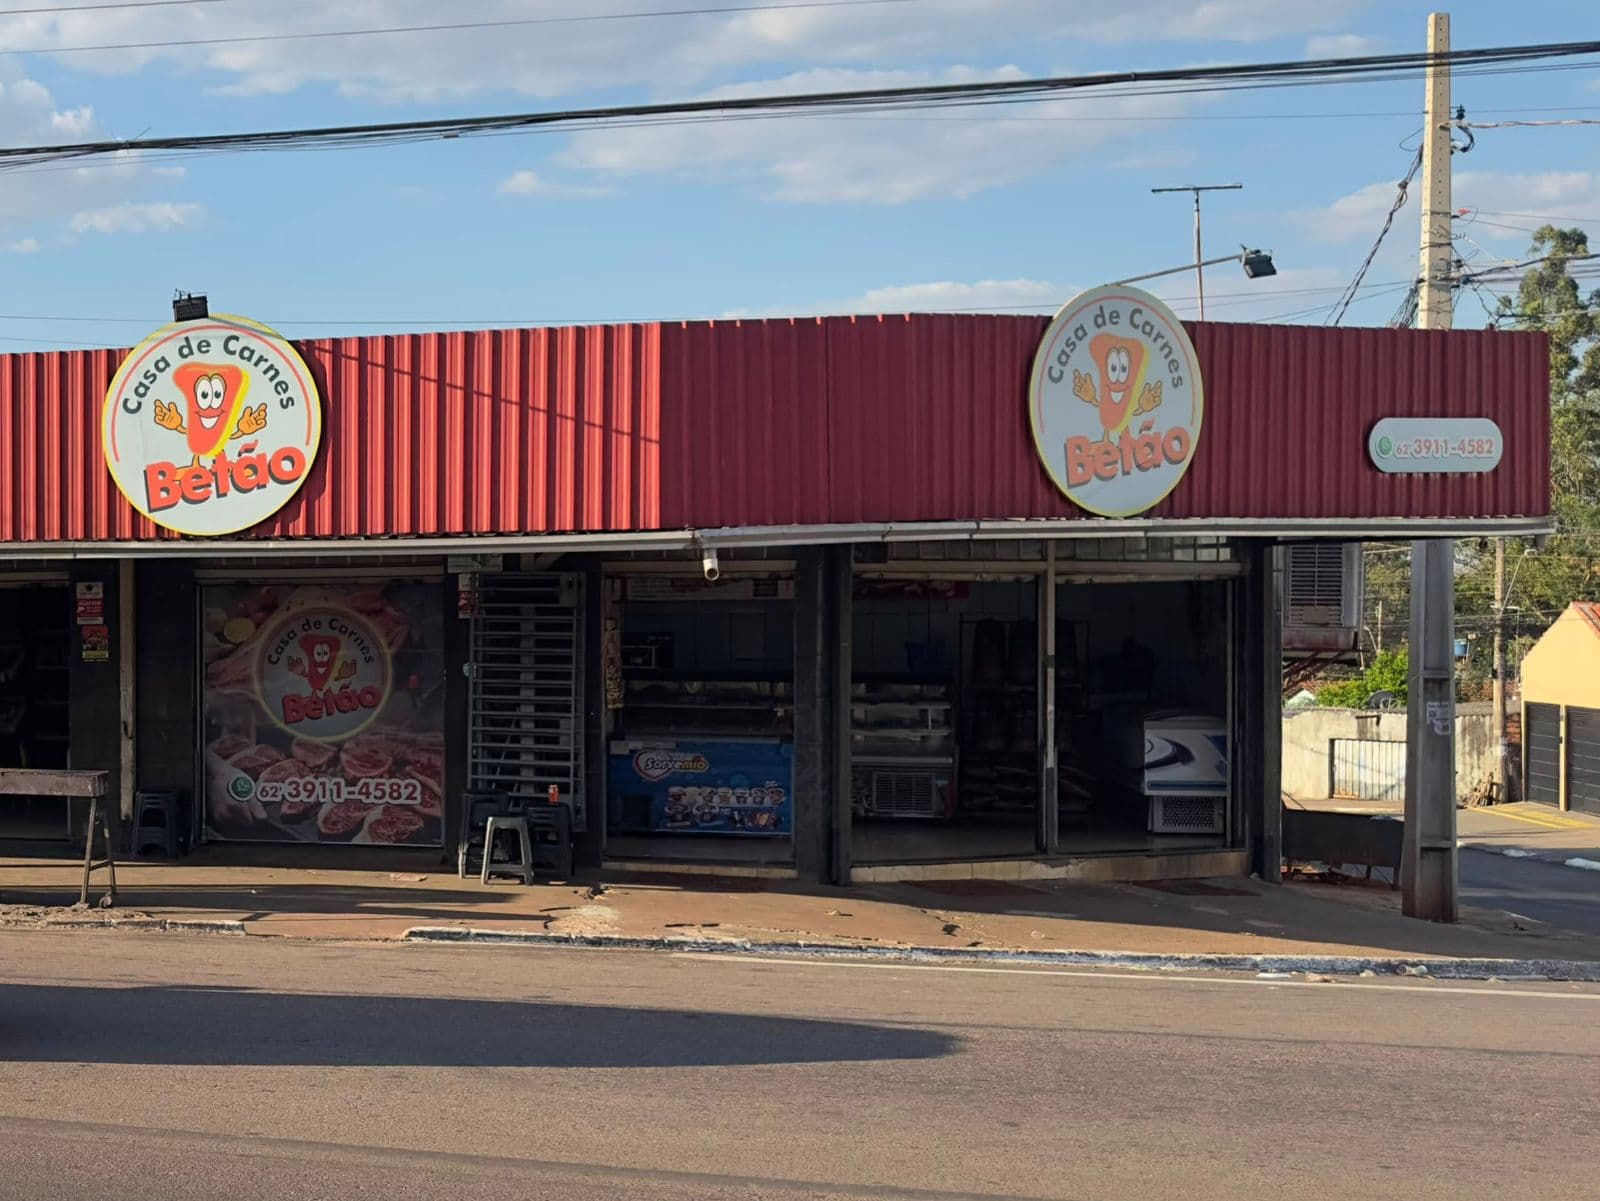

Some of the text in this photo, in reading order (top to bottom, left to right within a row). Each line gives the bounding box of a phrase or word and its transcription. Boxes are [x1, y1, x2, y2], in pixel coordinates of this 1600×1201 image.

[122, 335, 295, 415] Casa de Carnes
[1048, 305, 1183, 389] Casa de Carnes
[144, 439, 306, 513] Betão
[1064, 418, 1191, 489] Betão
[1413, 438, 1494, 455] 3911-4582
[267, 618, 374, 665] Casa de Carnes
[281, 680, 383, 724] Betão
[287, 780, 419, 801] 3911-4582
